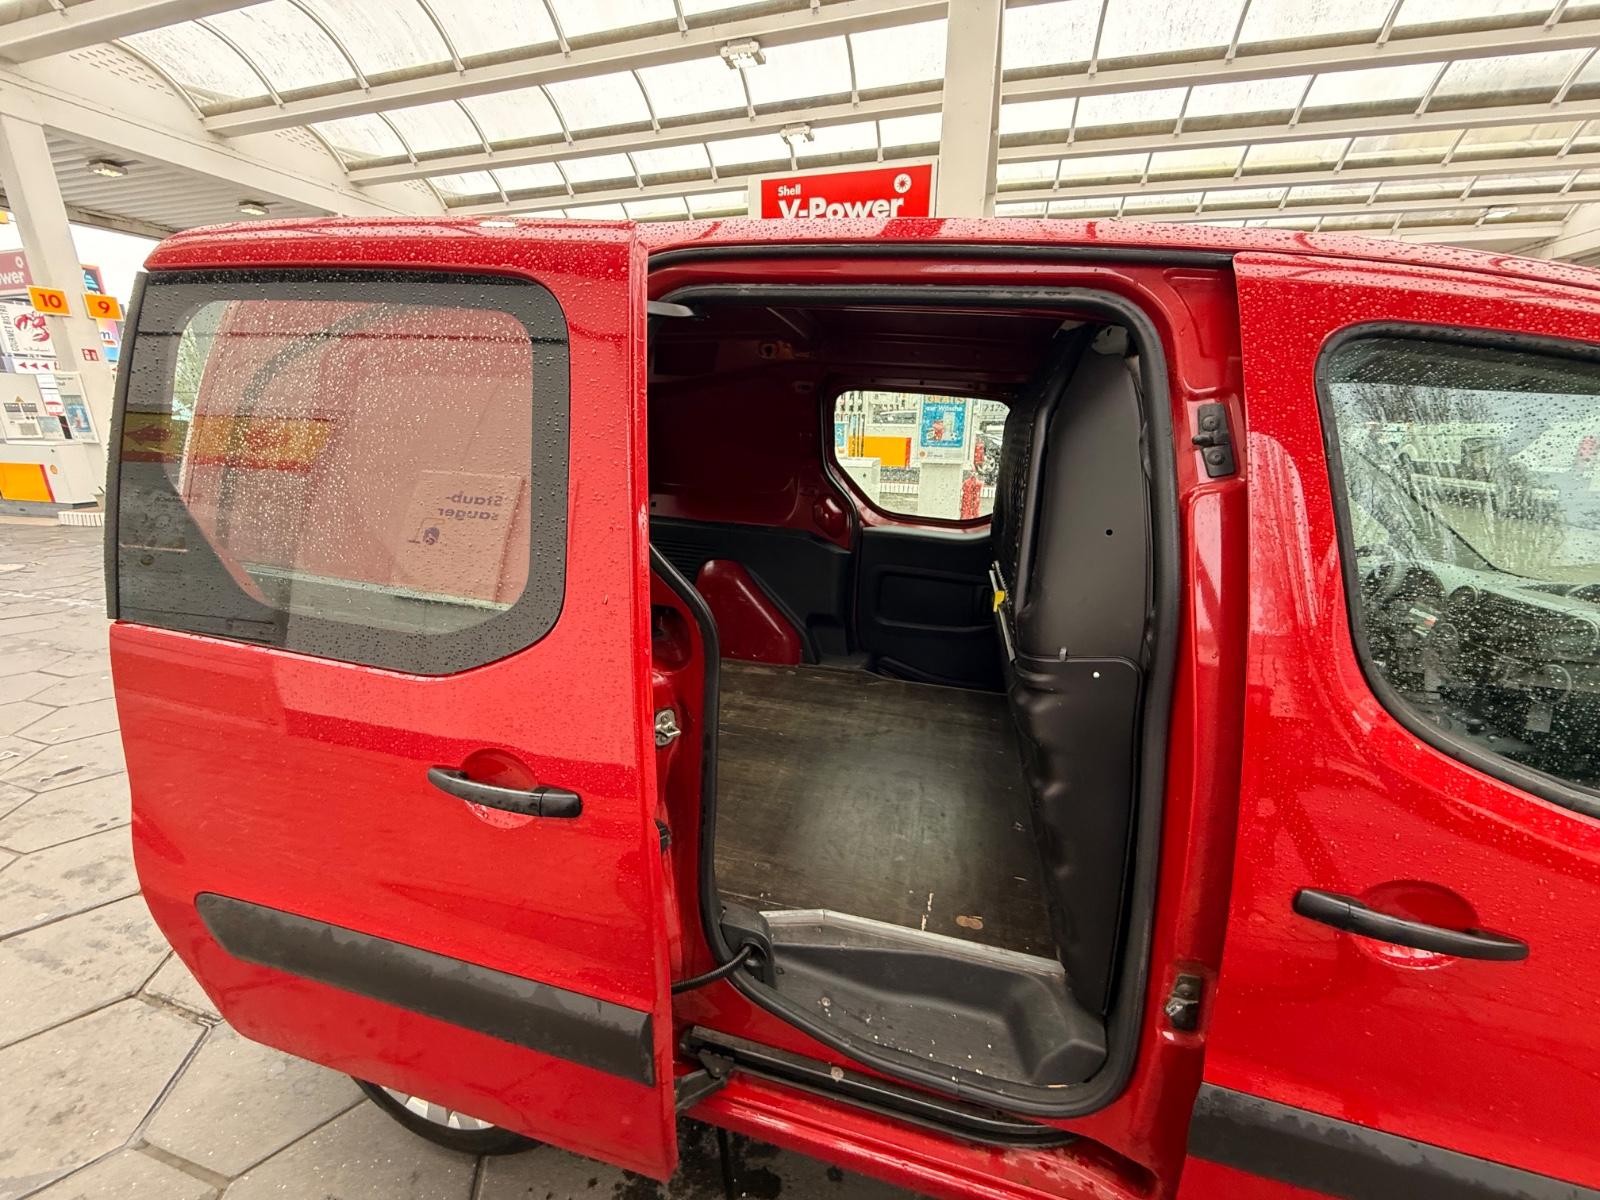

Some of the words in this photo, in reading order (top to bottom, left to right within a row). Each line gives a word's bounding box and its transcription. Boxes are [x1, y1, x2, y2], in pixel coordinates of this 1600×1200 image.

[778, 184, 801, 197] Shell
[778, 197, 904, 219] V-Power
[0, 271, 25, 285] wer
[38, 293, 63, 309] 10
[97, 301, 110, 314] 9
